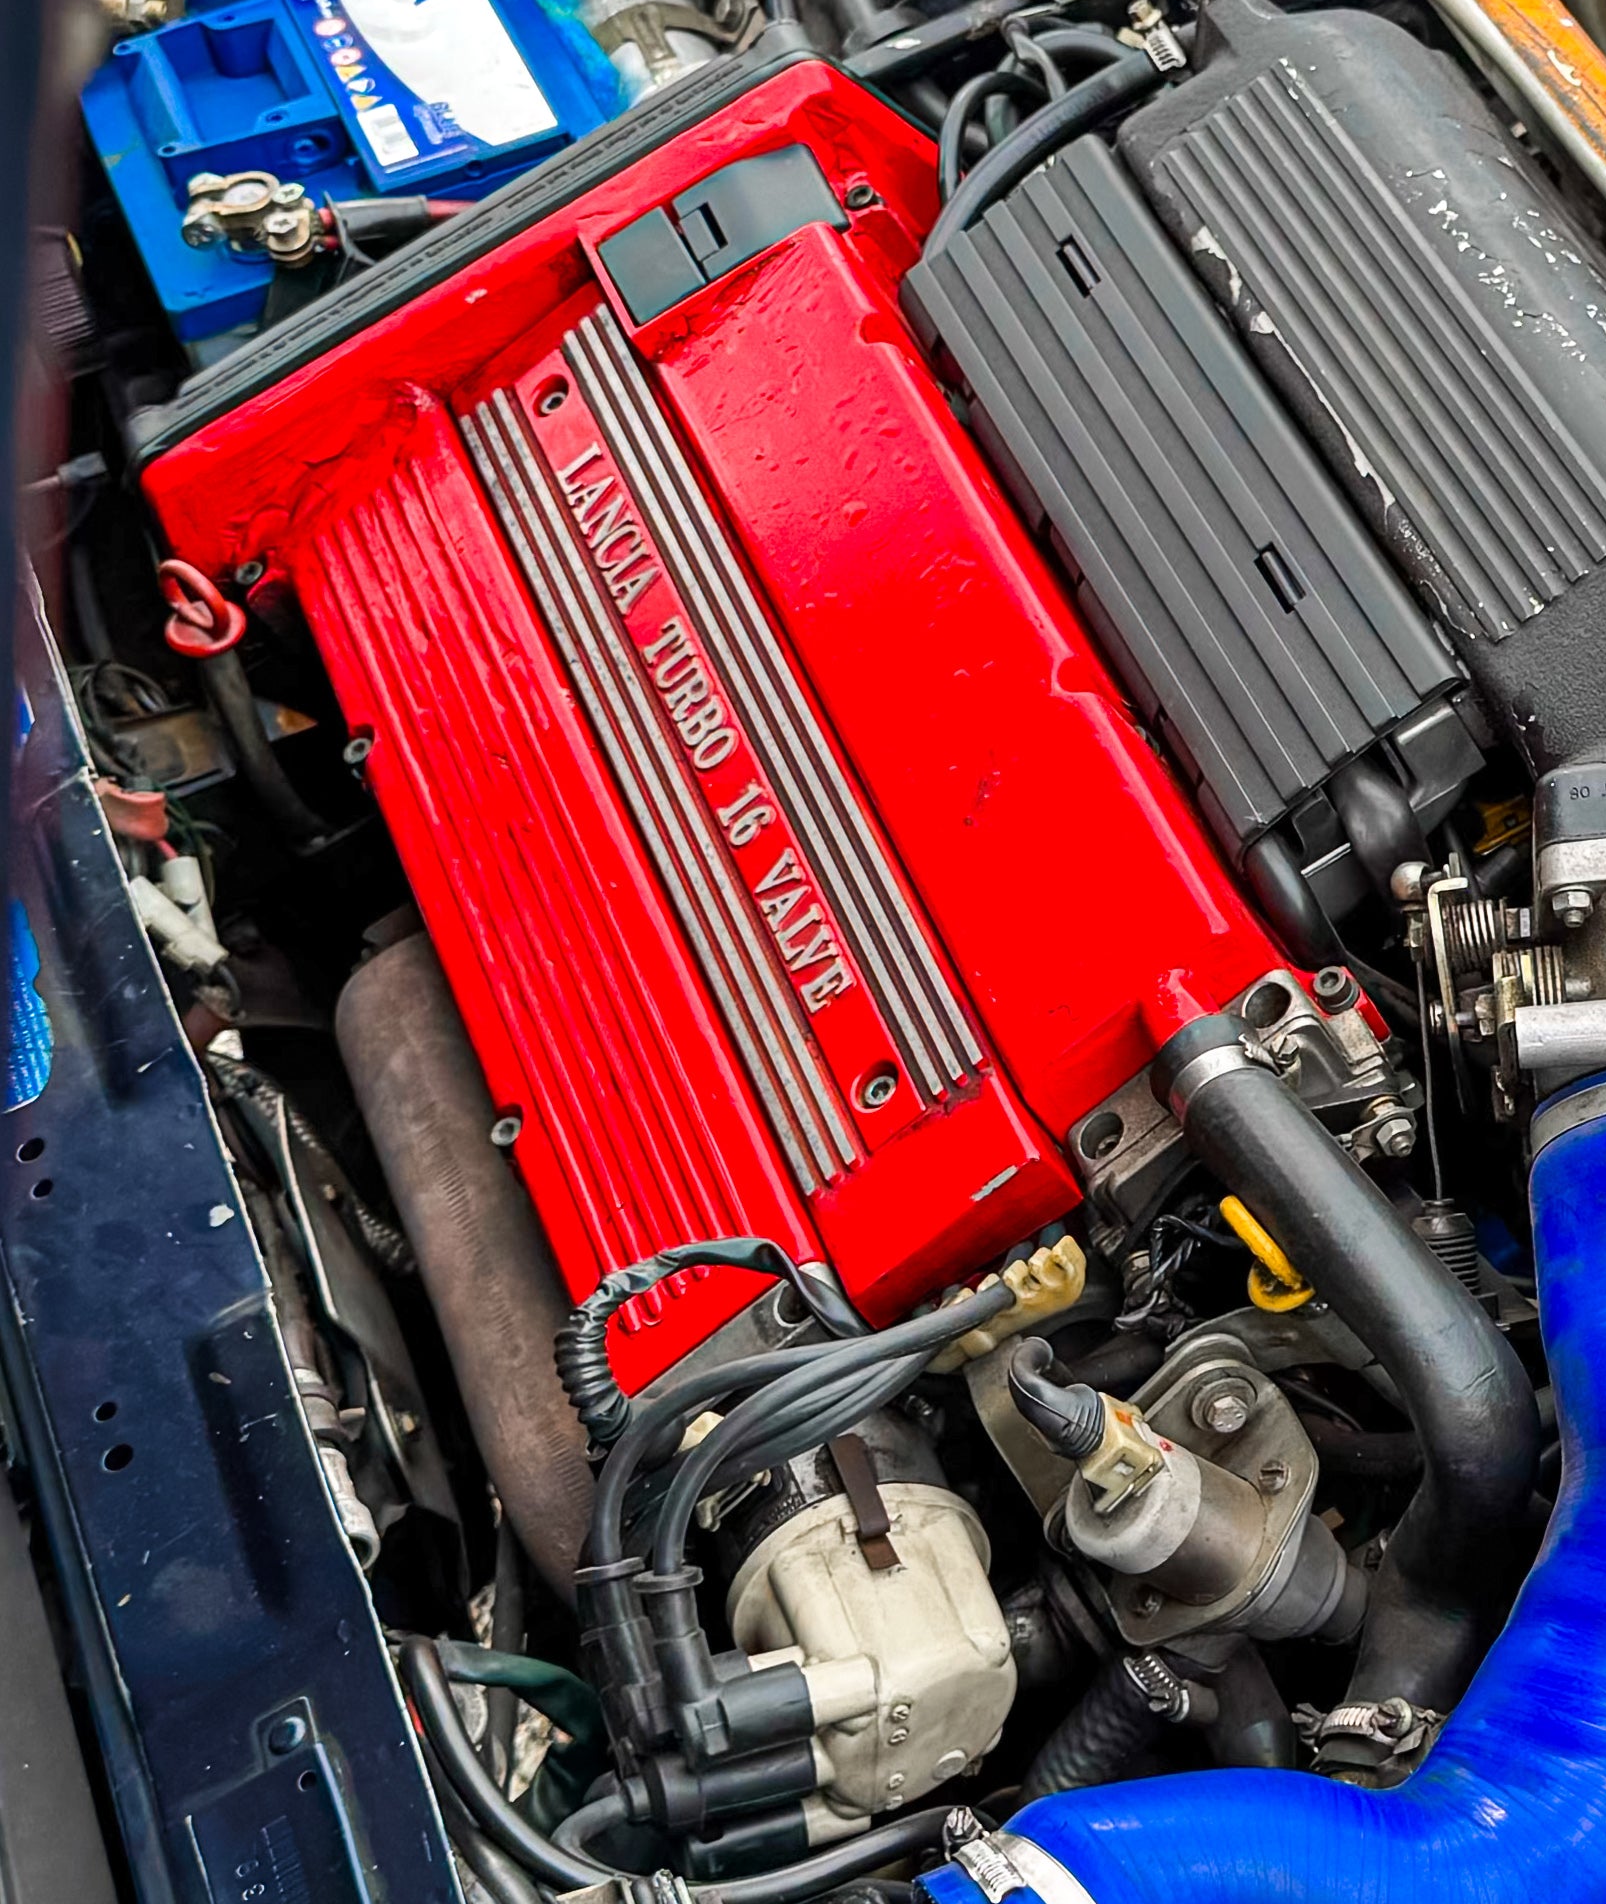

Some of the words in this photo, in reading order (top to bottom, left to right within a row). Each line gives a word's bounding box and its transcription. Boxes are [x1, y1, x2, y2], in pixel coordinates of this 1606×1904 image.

[557, 441, 663, 616] LANCIA
[643, 616, 740, 771] TURBO
[717, 780, 777, 848] 16
[755, 847, 855, 1014] VALVE
